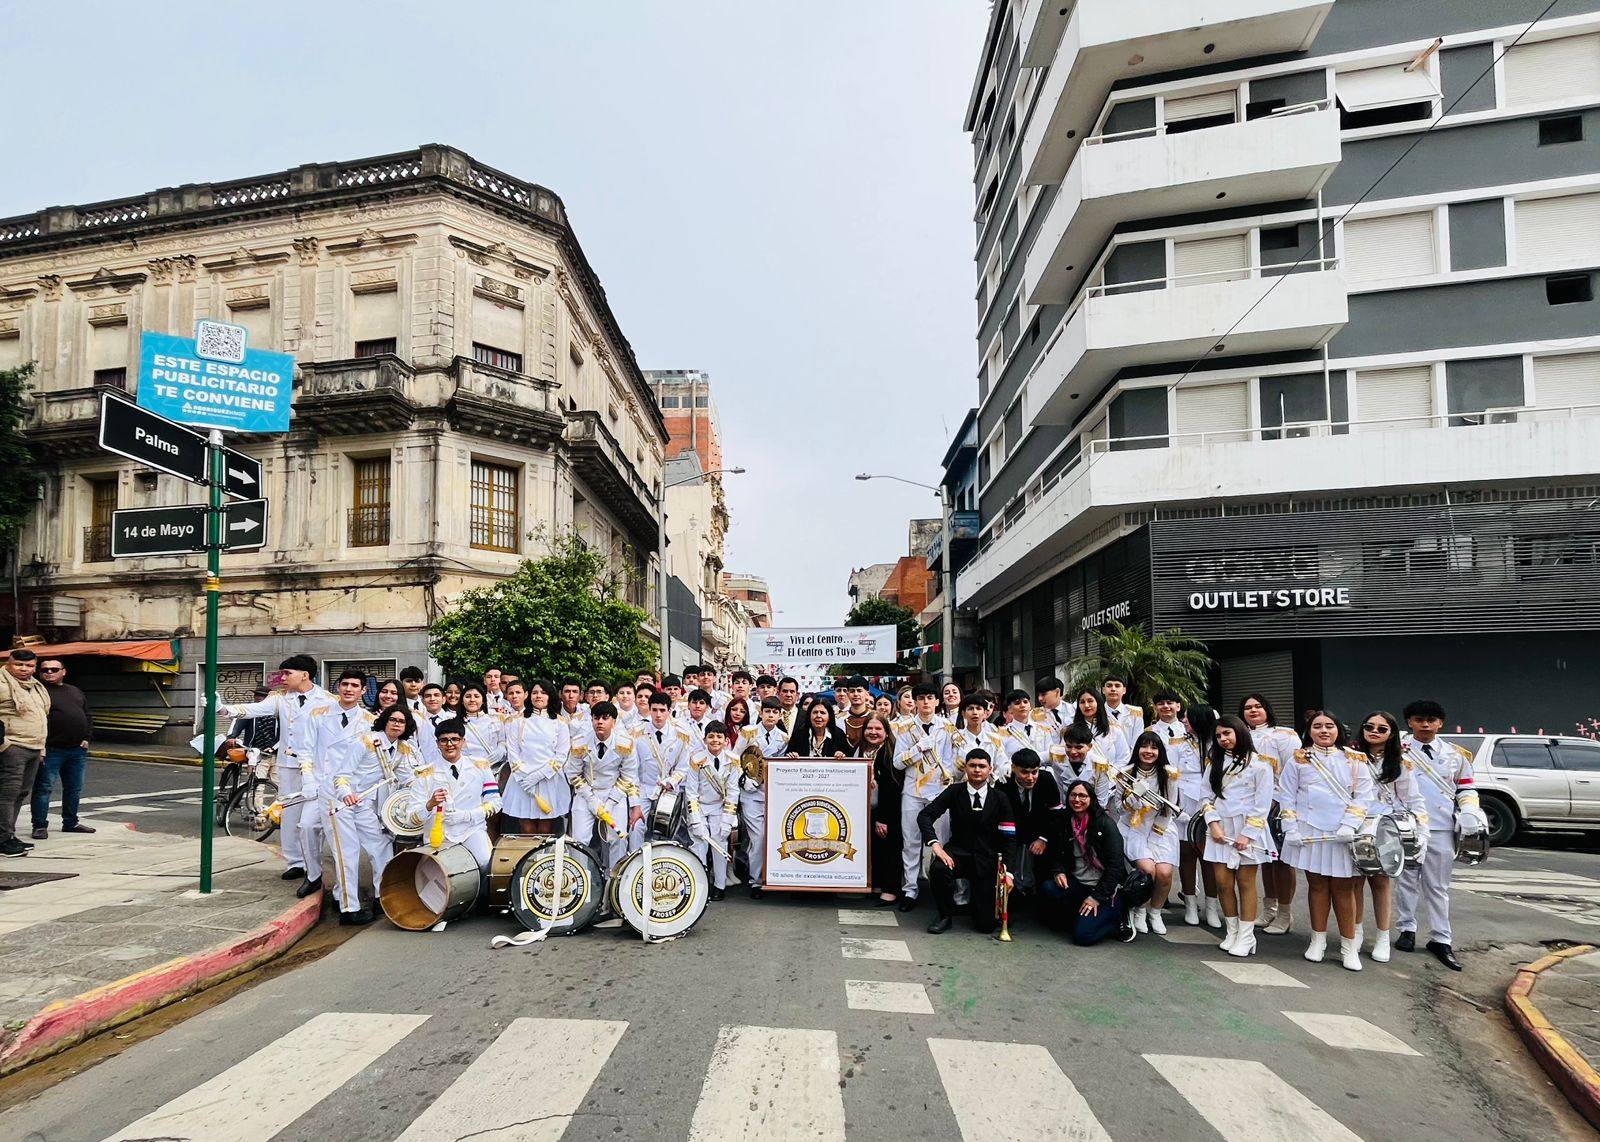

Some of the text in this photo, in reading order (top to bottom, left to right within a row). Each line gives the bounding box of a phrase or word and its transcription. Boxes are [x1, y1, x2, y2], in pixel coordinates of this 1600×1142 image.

[154, 354, 281, 384] ESTE ESPACIO
[152, 368, 278, 398] PUBLICITARIO
[154, 384, 178, 398] TE
[183, 388, 275, 412] CONVIENE
[134, 426, 180, 456] Palma
[123, 523, 194, 538] 14 de Mayo
[1189, 588, 1350, 610] OUTLET STORE
[1081, 600, 1131, 631] OUTLET STORE
[807, 635, 815, 645] el
[787, 647, 856, 657] El Centro es Tuyo
[651, 875, 676, 892] 60
[652, 909, 677, 918] FROSEP
